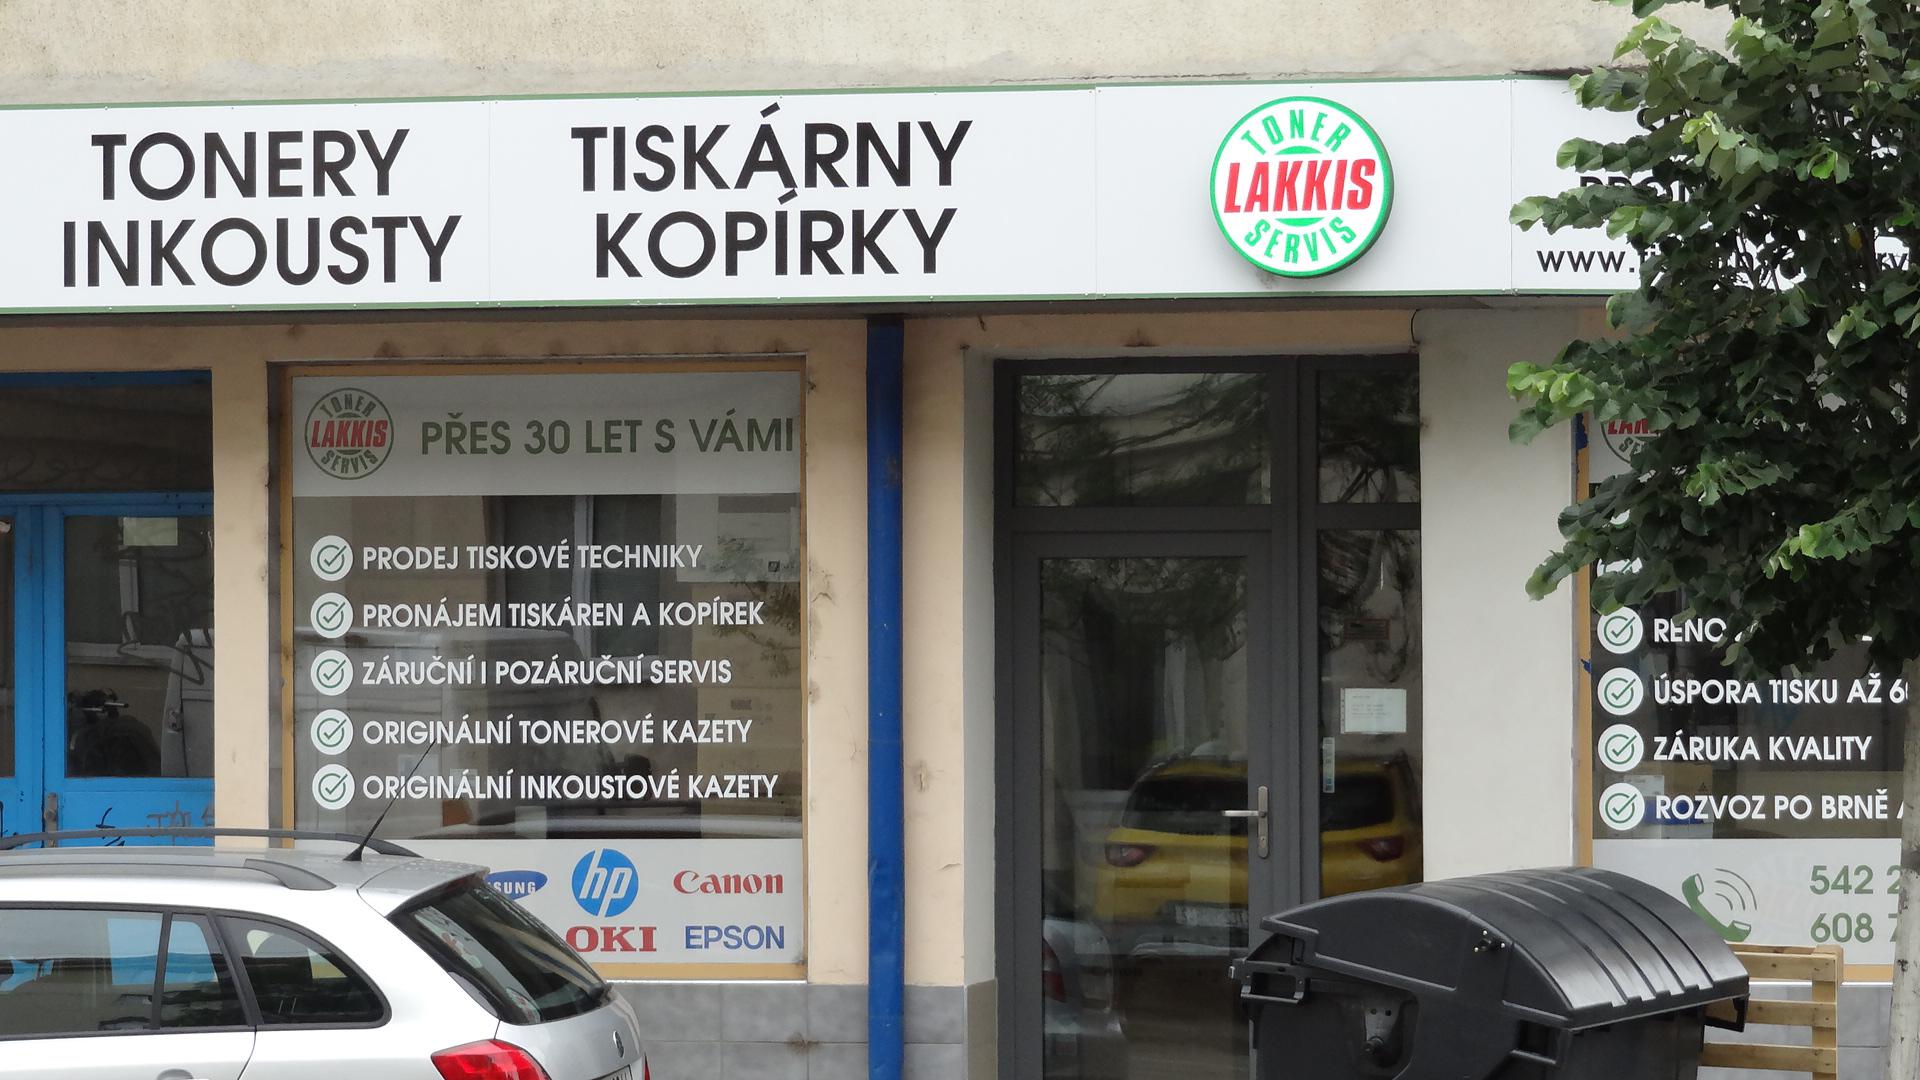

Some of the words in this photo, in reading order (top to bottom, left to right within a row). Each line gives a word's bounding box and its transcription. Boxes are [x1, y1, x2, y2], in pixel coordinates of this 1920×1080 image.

[571, 102, 973, 191] TISKÁRNY
[1241, 109, 1352, 155] TONER
[92, 129, 410, 200] TONERY
[1224, 159, 1376, 213] LAKKIS
[596, 188, 958, 278] KOPÍRKY
[1244, 217, 1357, 264] SERVIS
[64, 215, 462, 287] INKOUSTY
[320, 393, 377, 417] TONER
[311, 420, 388, 448] LAKKIS
[422, 412, 511, 455] PŘES
[524, 419, 571, 455] 30
[586, 419, 643, 453] LET
[655, 418, 676, 453] S
[689, 408, 794, 452] VÁMI
[321, 449, 379, 474] SERVIS
[363, 547, 458, 570] PRODEJ
[467, 538, 570, 569] TISKOVÉ
[578, 544, 703, 568] TECHNIKY
[363, 597, 501, 628] PRONÁJEM
[509, 596, 623, 626] TISKÁREN
[631, 602, 651, 626] A
[660, 595, 764, 625] KOPÍREK
[362, 654, 474, 685] ZÁRUČNÍ
[481, 661, 487, 685] I
[496, 653, 644, 684] POZÁRUČNÍ
[650, 659, 732, 684] SERVIS
[1655, 672, 1762, 704] ÚSPORA
[1769, 679, 1838, 704] TISKU
[1847, 672, 1882, 703] AŽ
[1890, 679, 1908, 703] 6
[362, 713, 514, 744] ORIGINÁLNÍ
[519, 712, 654, 744] TONEROVÉ
[663, 719, 753, 744] KAZETY
[1654, 729, 1761, 761] ZÁRUKA
[1769, 736, 1872, 761] KVALITY
[362, 769, 514, 799] ORIGINÁLNÍ
[521, 768, 680, 799] INKOUSTOVÉ
[689, 774, 779, 799] KAZETY
[1656, 795, 1766, 820] ROZVOZ
[1775, 795, 1813, 820] PO
[1821, 788, 1888, 819] BRNĚ
[493, 881, 536, 895] SUNG
[577, 848, 634, 917] hp
[673, 870, 784, 894] Canon
[1810, 864, 1874, 895] 542
[566, 926, 657, 952] OKI
[685, 925, 785, 949] EPSON
[1810, 912, 1874, 943] 608
